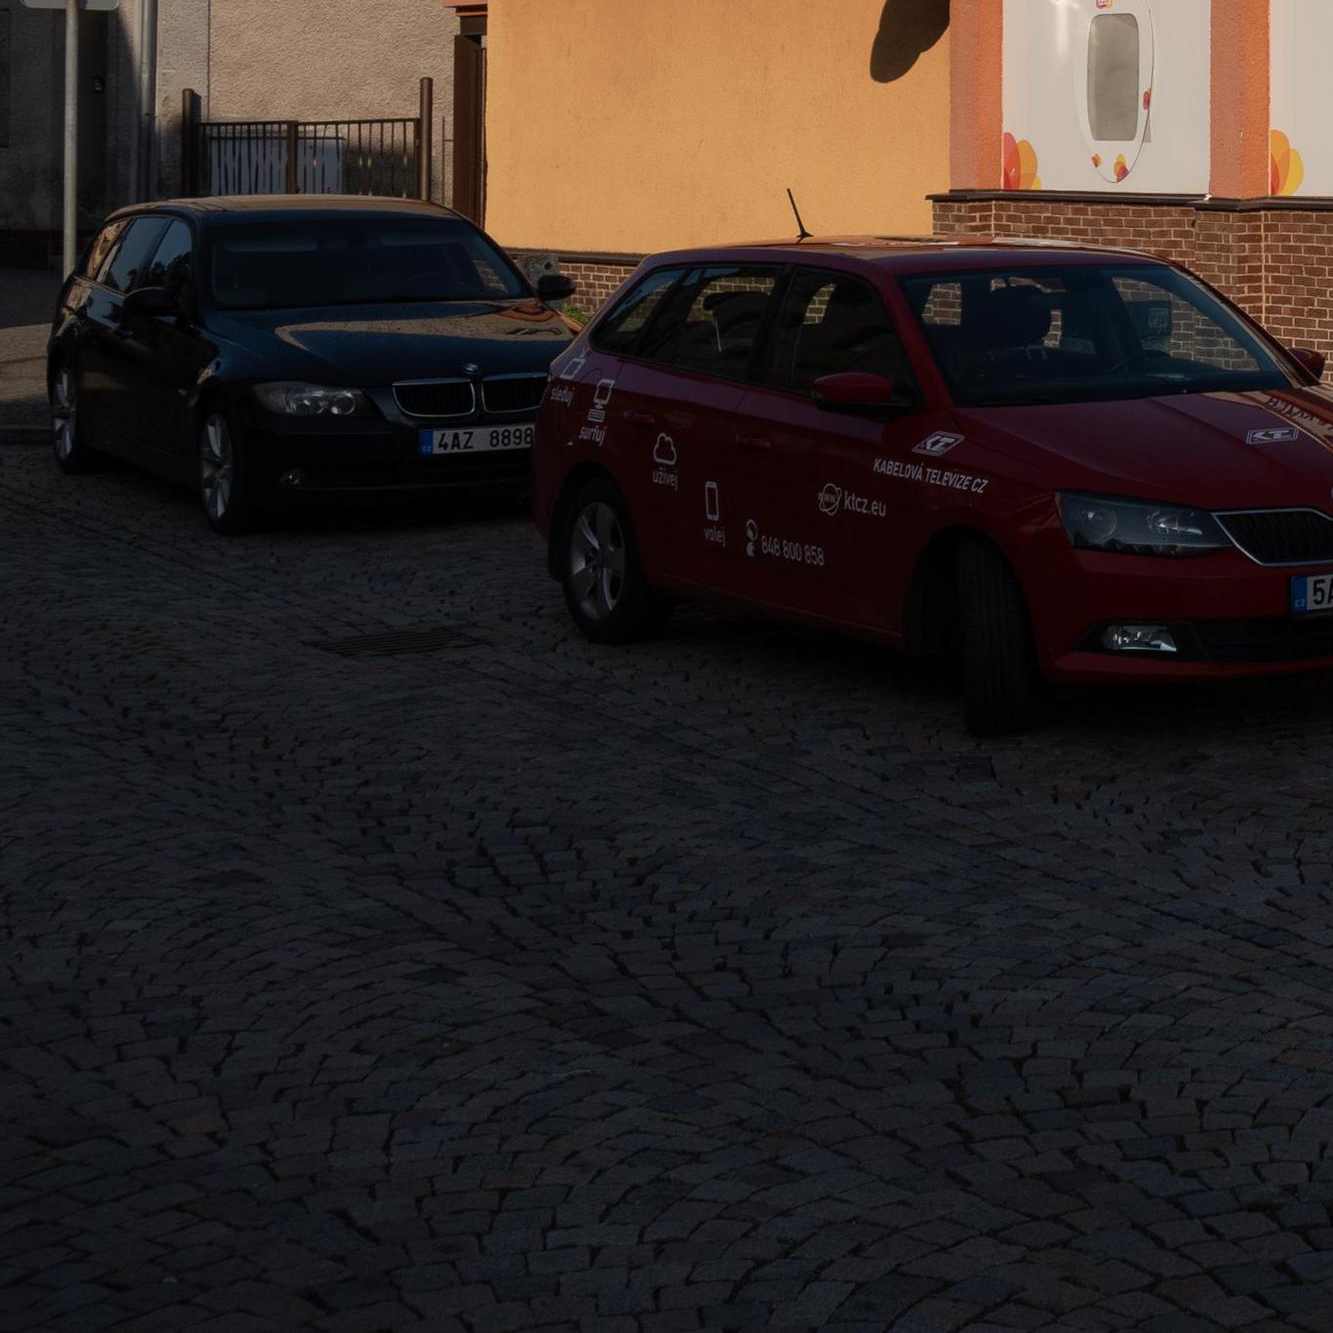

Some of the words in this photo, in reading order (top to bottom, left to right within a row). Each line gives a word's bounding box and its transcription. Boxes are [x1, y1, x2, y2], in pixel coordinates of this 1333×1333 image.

[438, 431, 475, 451] 4AZ
[489, 427, 534, 447] 8898
[872, 456, 924, 482] KABELOVÁ
[925, 468, 973, 491] TELEVIZE
[970, 478, 990, 494] CZ
[843, 490, 888, 518] ktcz.eu
[703, 524, 727, 548] volej
[760, 534, 781, 557] 848
[783, 539, 801, 562] 800
[803, 543, 826, 567] 858
